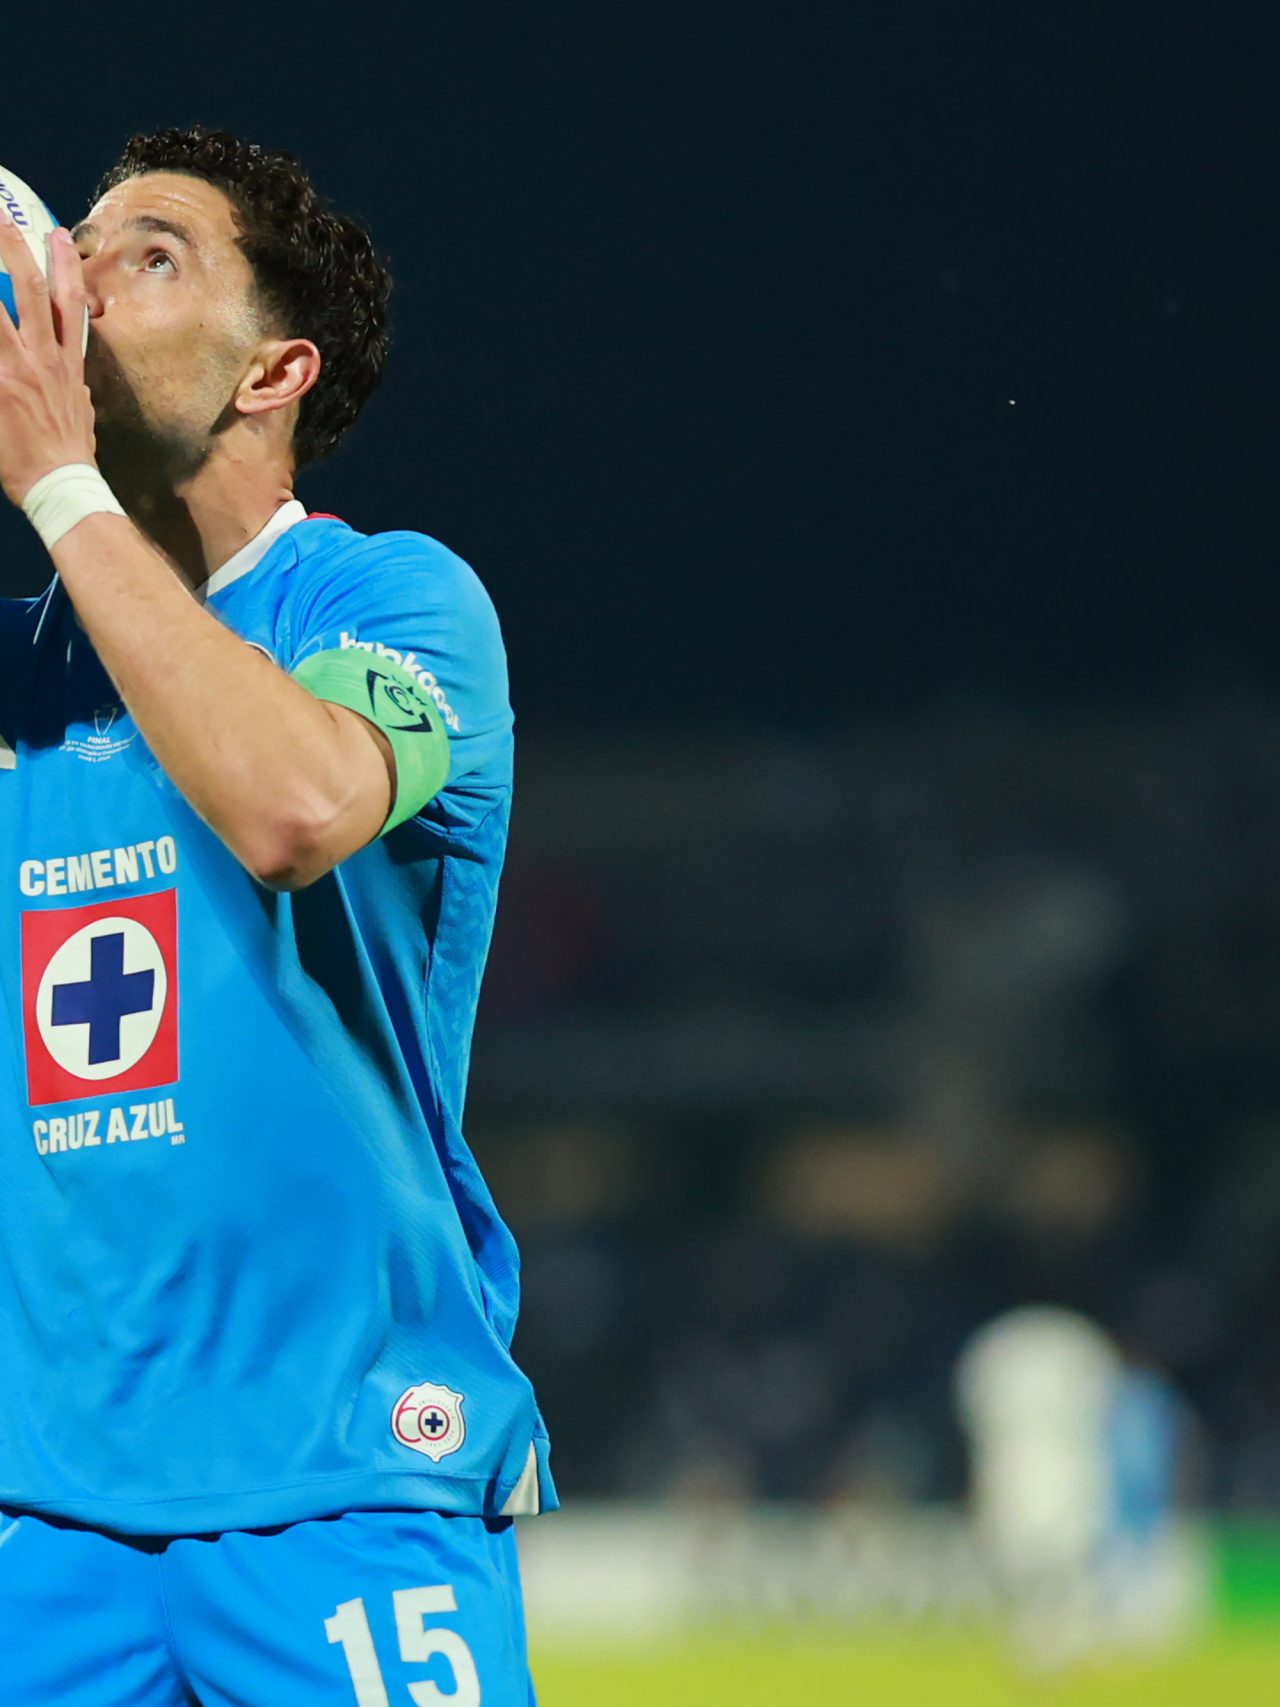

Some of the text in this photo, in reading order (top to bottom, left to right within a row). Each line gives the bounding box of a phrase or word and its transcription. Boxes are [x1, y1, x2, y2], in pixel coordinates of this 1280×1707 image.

[19, 835, 177, 897] CEMENTO
[32, 1098, 184, 1156] CRUZ AZUL
[323, 1583, 482, 1707] 15
